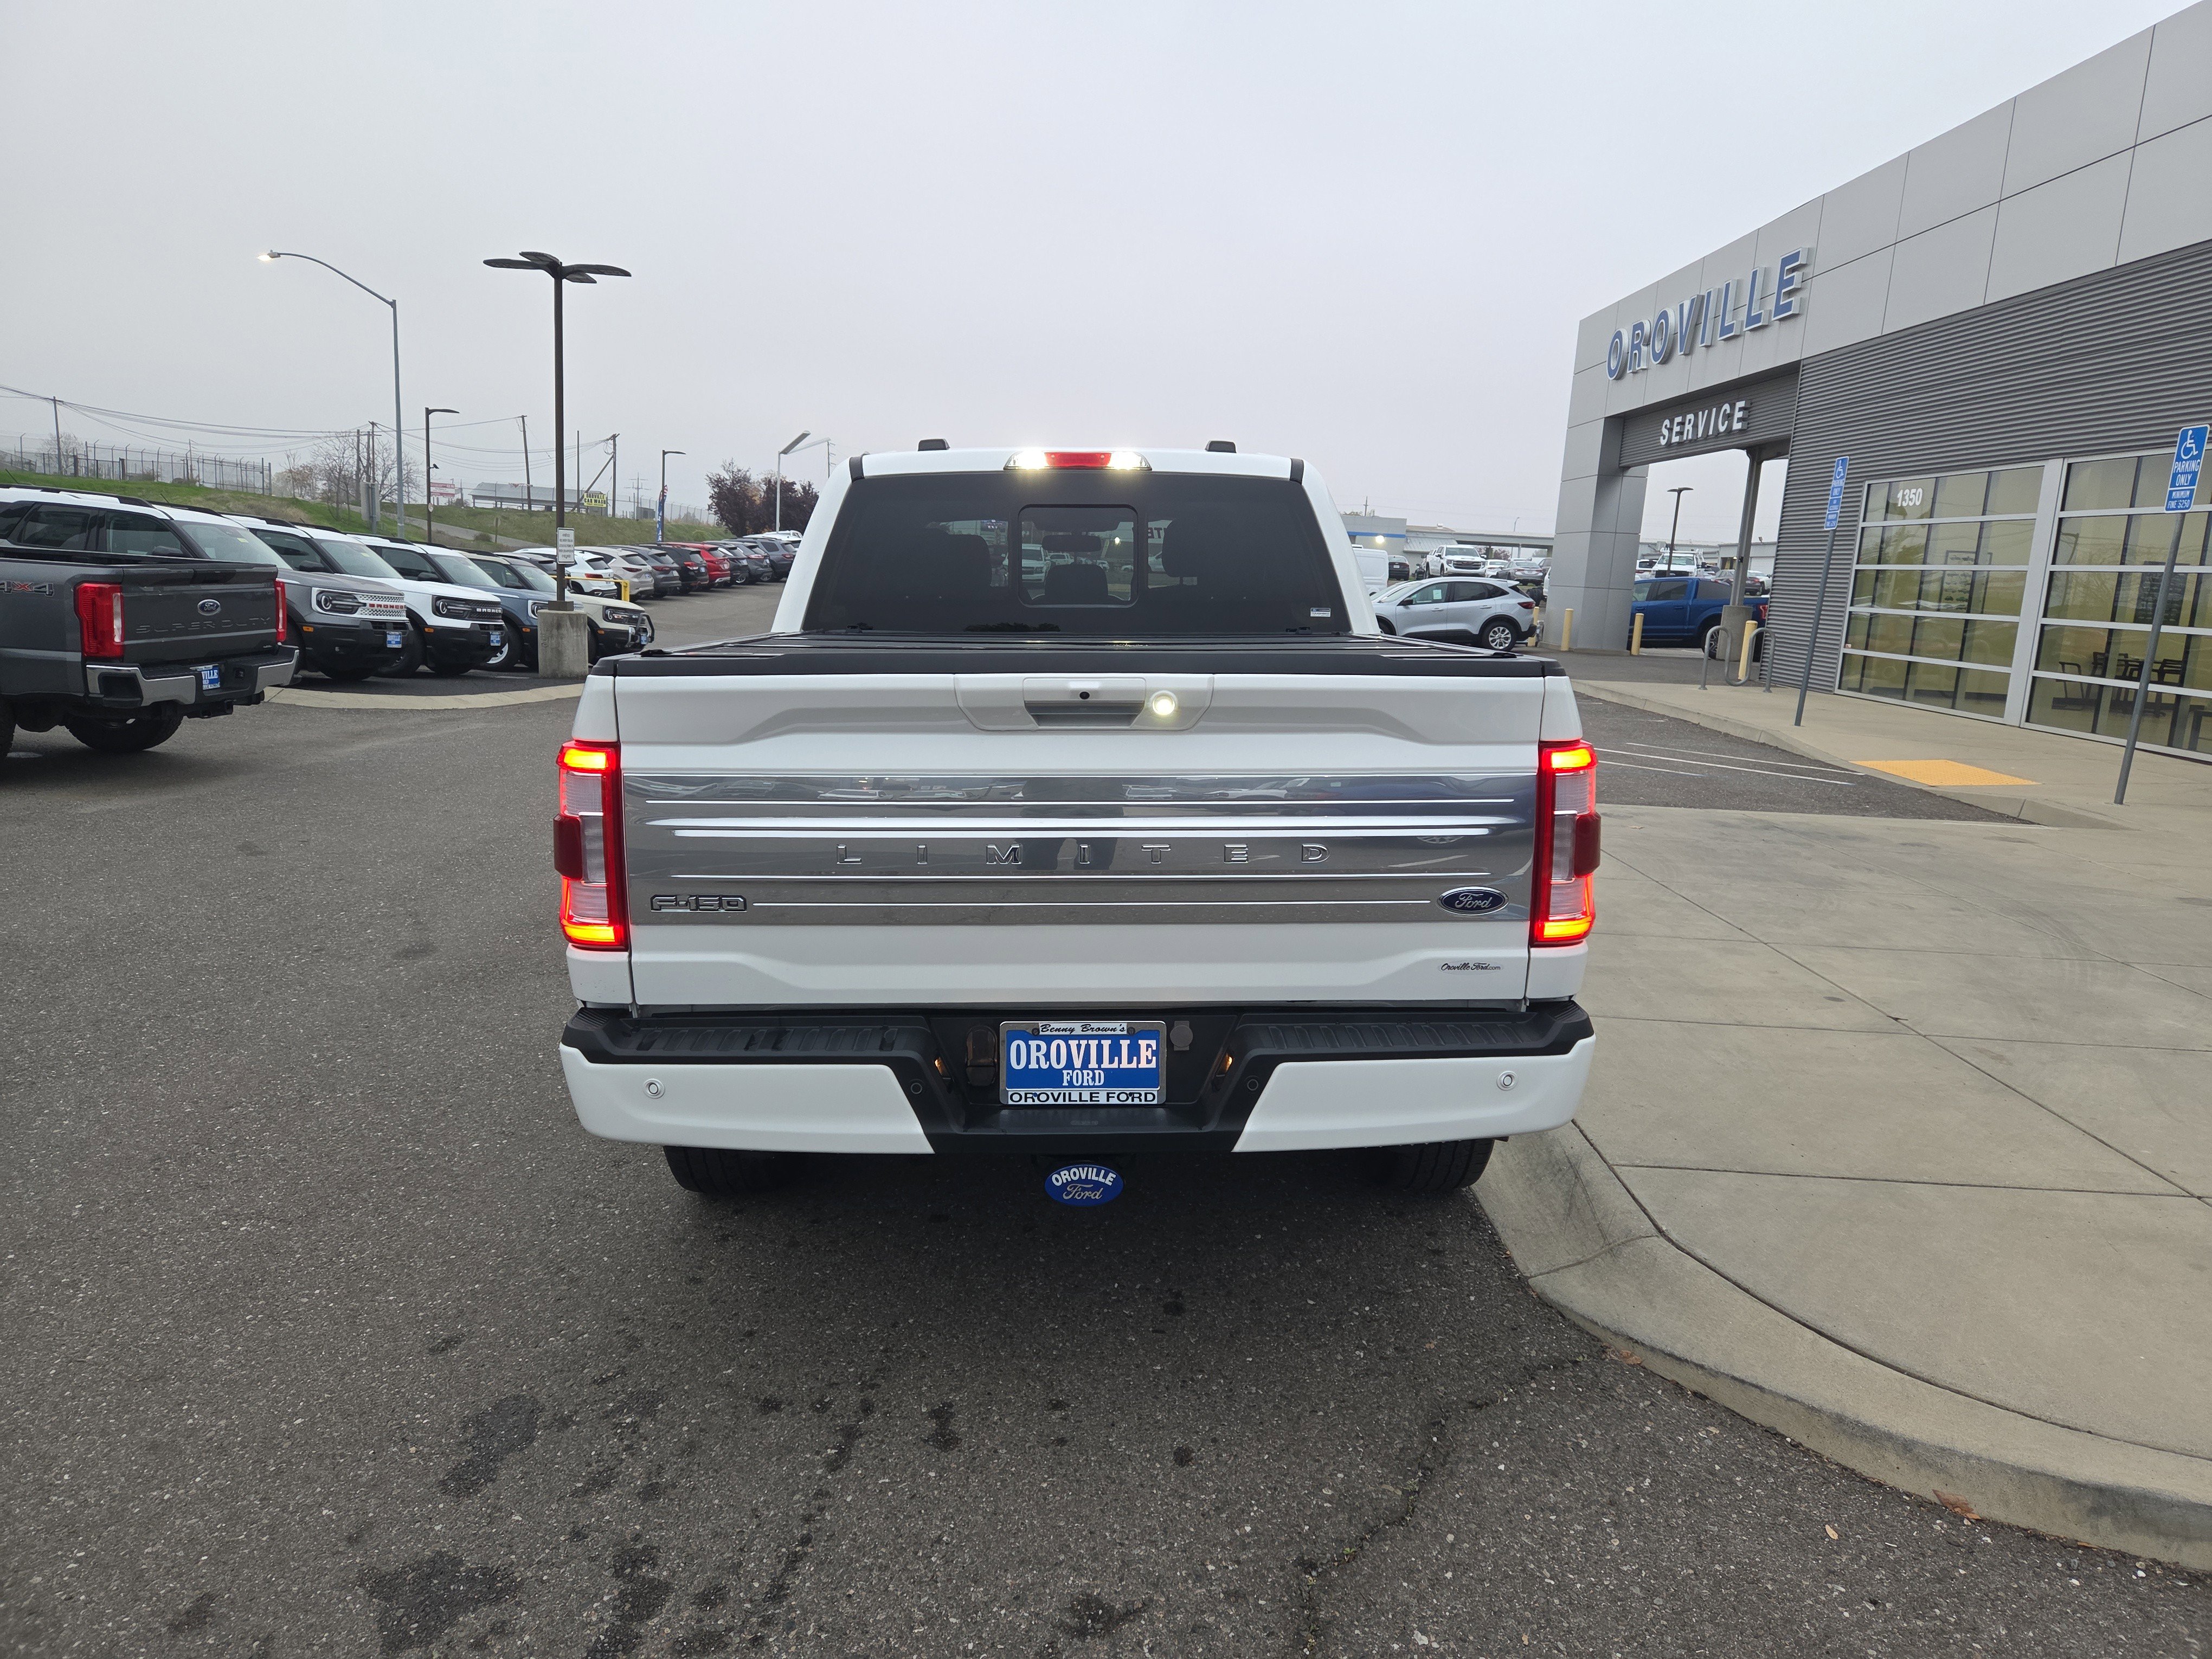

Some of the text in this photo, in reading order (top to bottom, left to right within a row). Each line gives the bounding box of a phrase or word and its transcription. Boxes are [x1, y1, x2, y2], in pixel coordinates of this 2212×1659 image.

[1606, 247, 1809, 380] OROVILLE
[1660, 401, 1748, 446] SERVICE
[2174, 459, 2200, 473] PARKING
[2176, 474, 2192, 486] ONLY
[1897, 488, 1922, 506] 1350
[837, 844, 1330, 864] LIMITED
[651, 895, 747, 912] F-150
[1455, 893, 1493, 908] Ford
[1441, 962, 1501, 970] Oroville Ford.com
[1040, 1024, 1126, 1034] Benny Brown's
[1010, 1039, 1156, 1069] OROVILLE
[1062, 1070, 1104, 1086] FORD
[1009, 1092, 1156, 1103] OROVILLE FORD
[1051, 1167, 1116, 1186] OROVILLE
[1063, 1184, 1103, 1200] Ford
